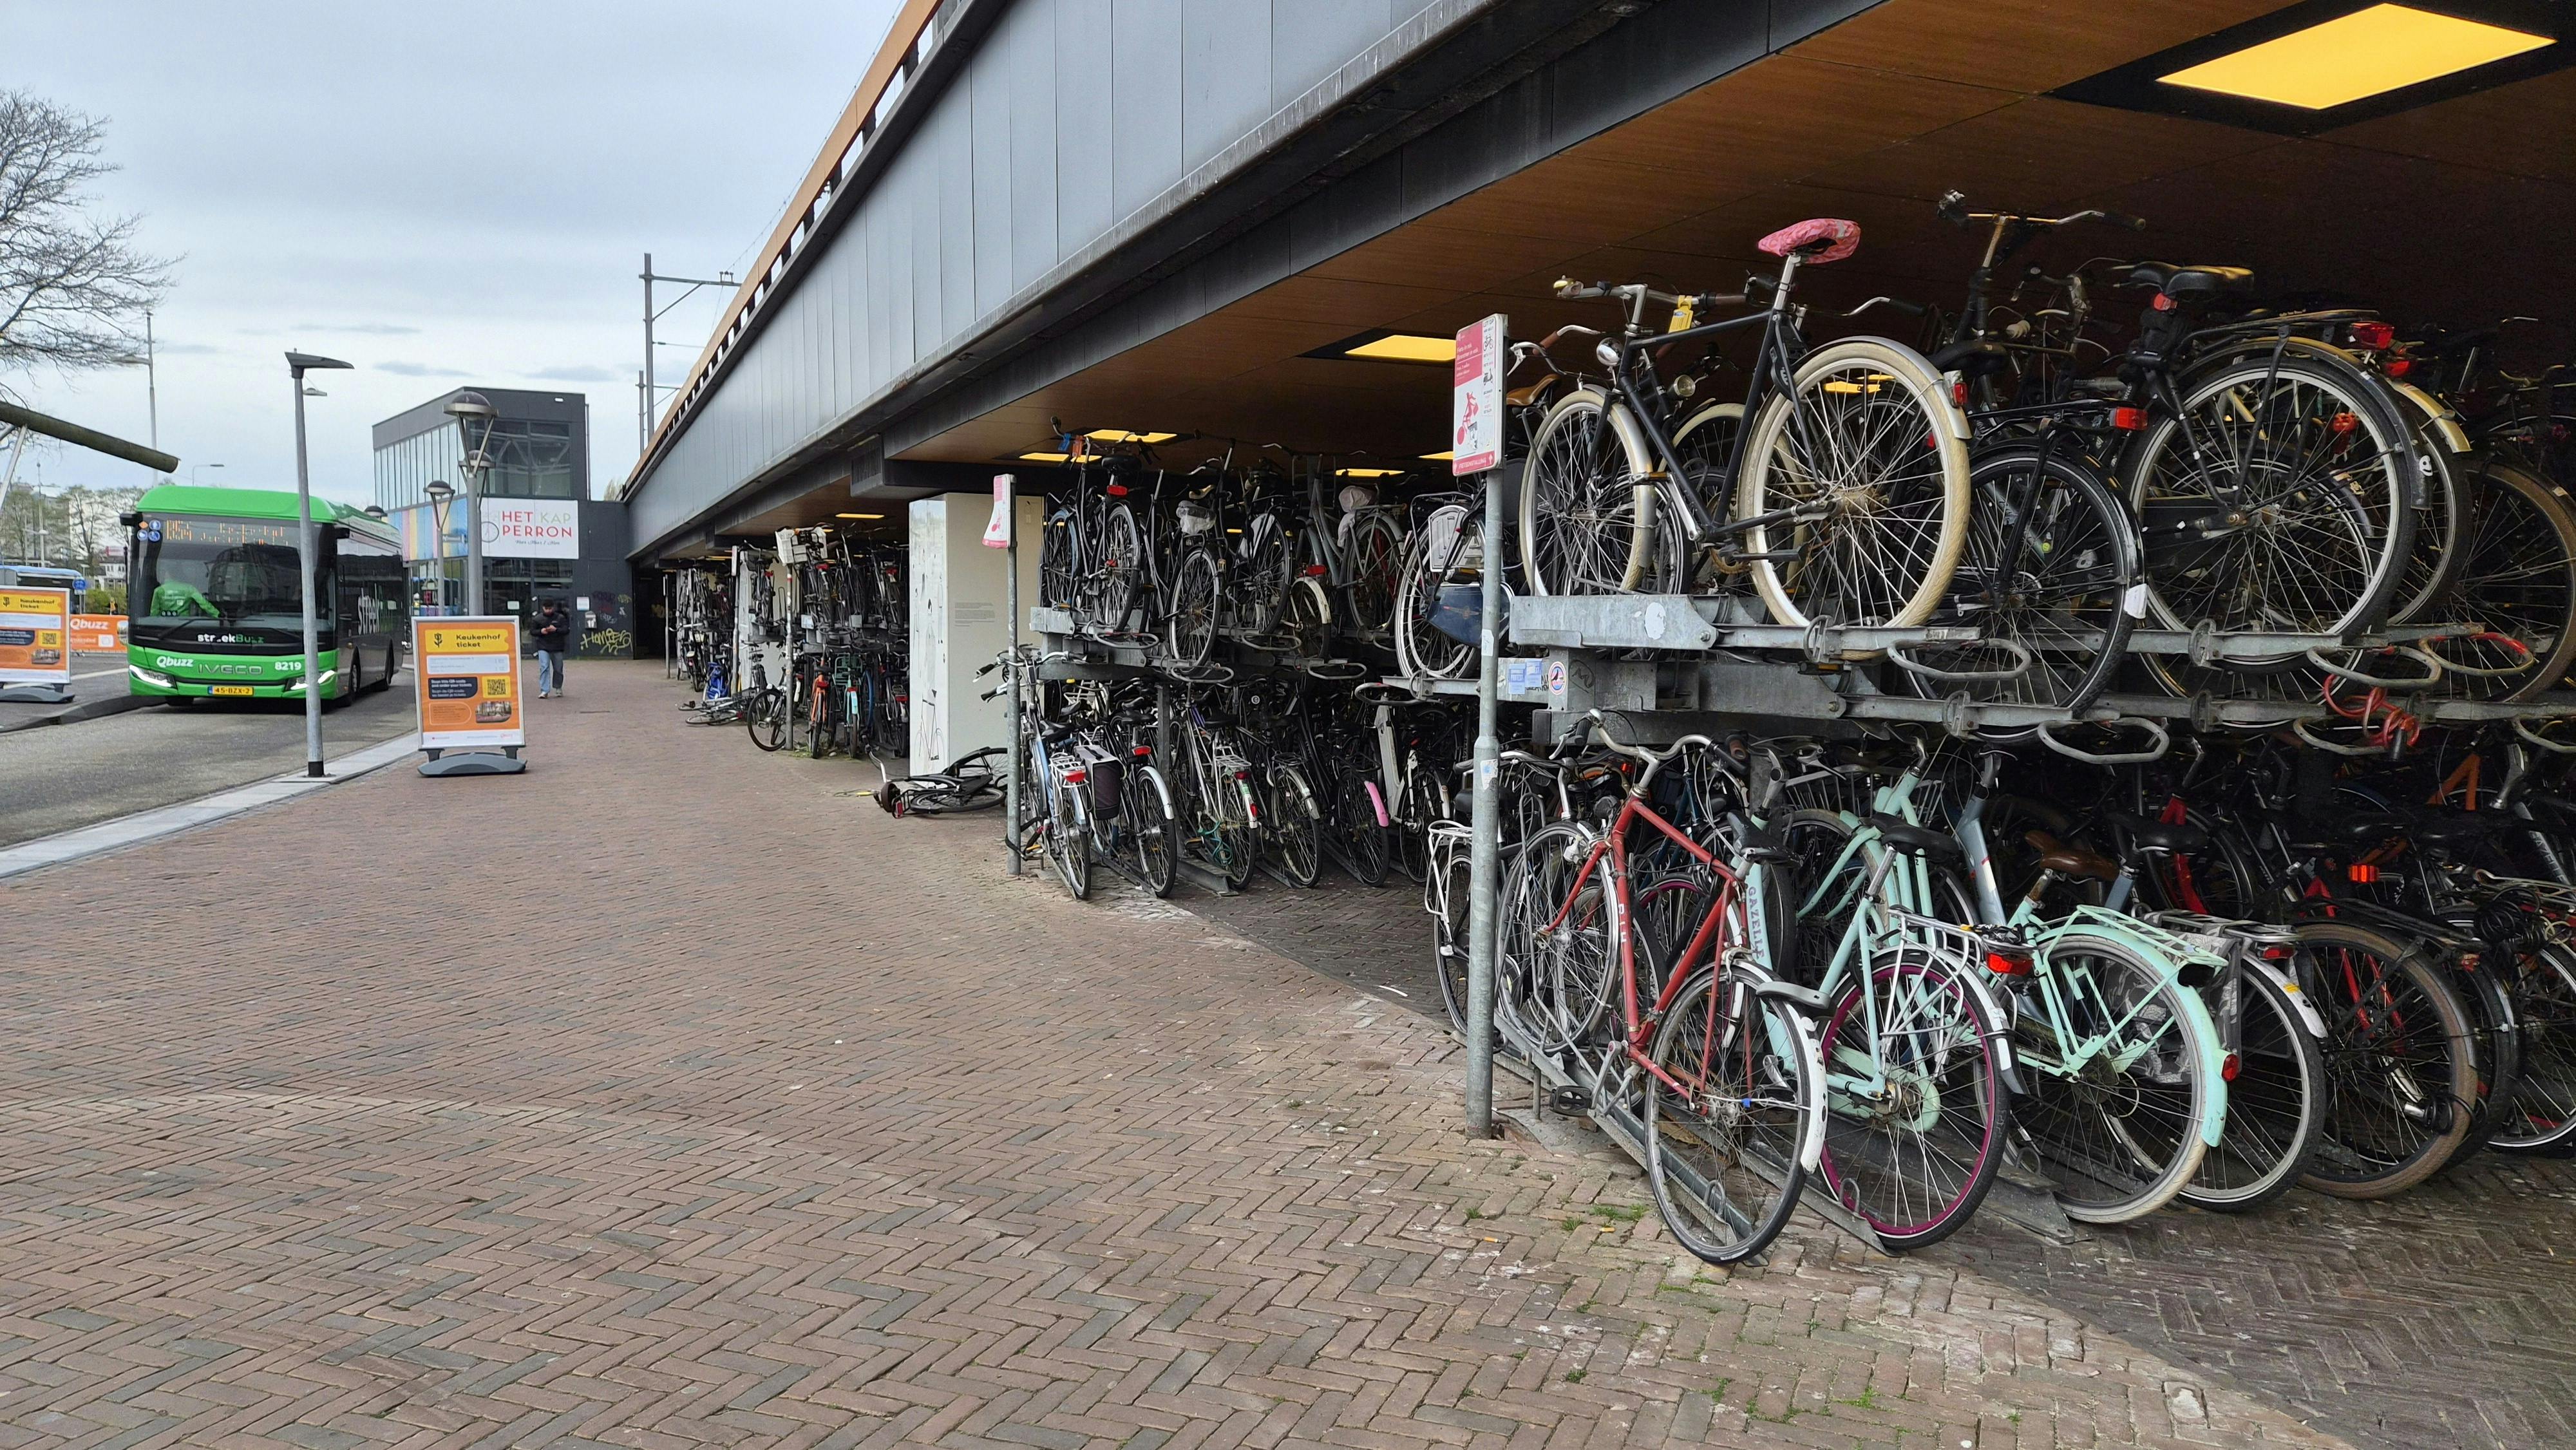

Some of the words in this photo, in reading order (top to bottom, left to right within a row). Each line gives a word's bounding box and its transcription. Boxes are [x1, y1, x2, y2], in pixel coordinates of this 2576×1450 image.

[502, 511, 533, 523] HET
[540, 512, 571, 524] KAP
[502, 525, 572, 538] PERRON
[70, 618, 109, 630] Qbuzz
[156, 655, 194, 668] Qbuzz
[274, 661, 302, 671] 8219
[198, 664, 263, 675] IVECO
[1748, 886, 1765, 960] GAZELLE
